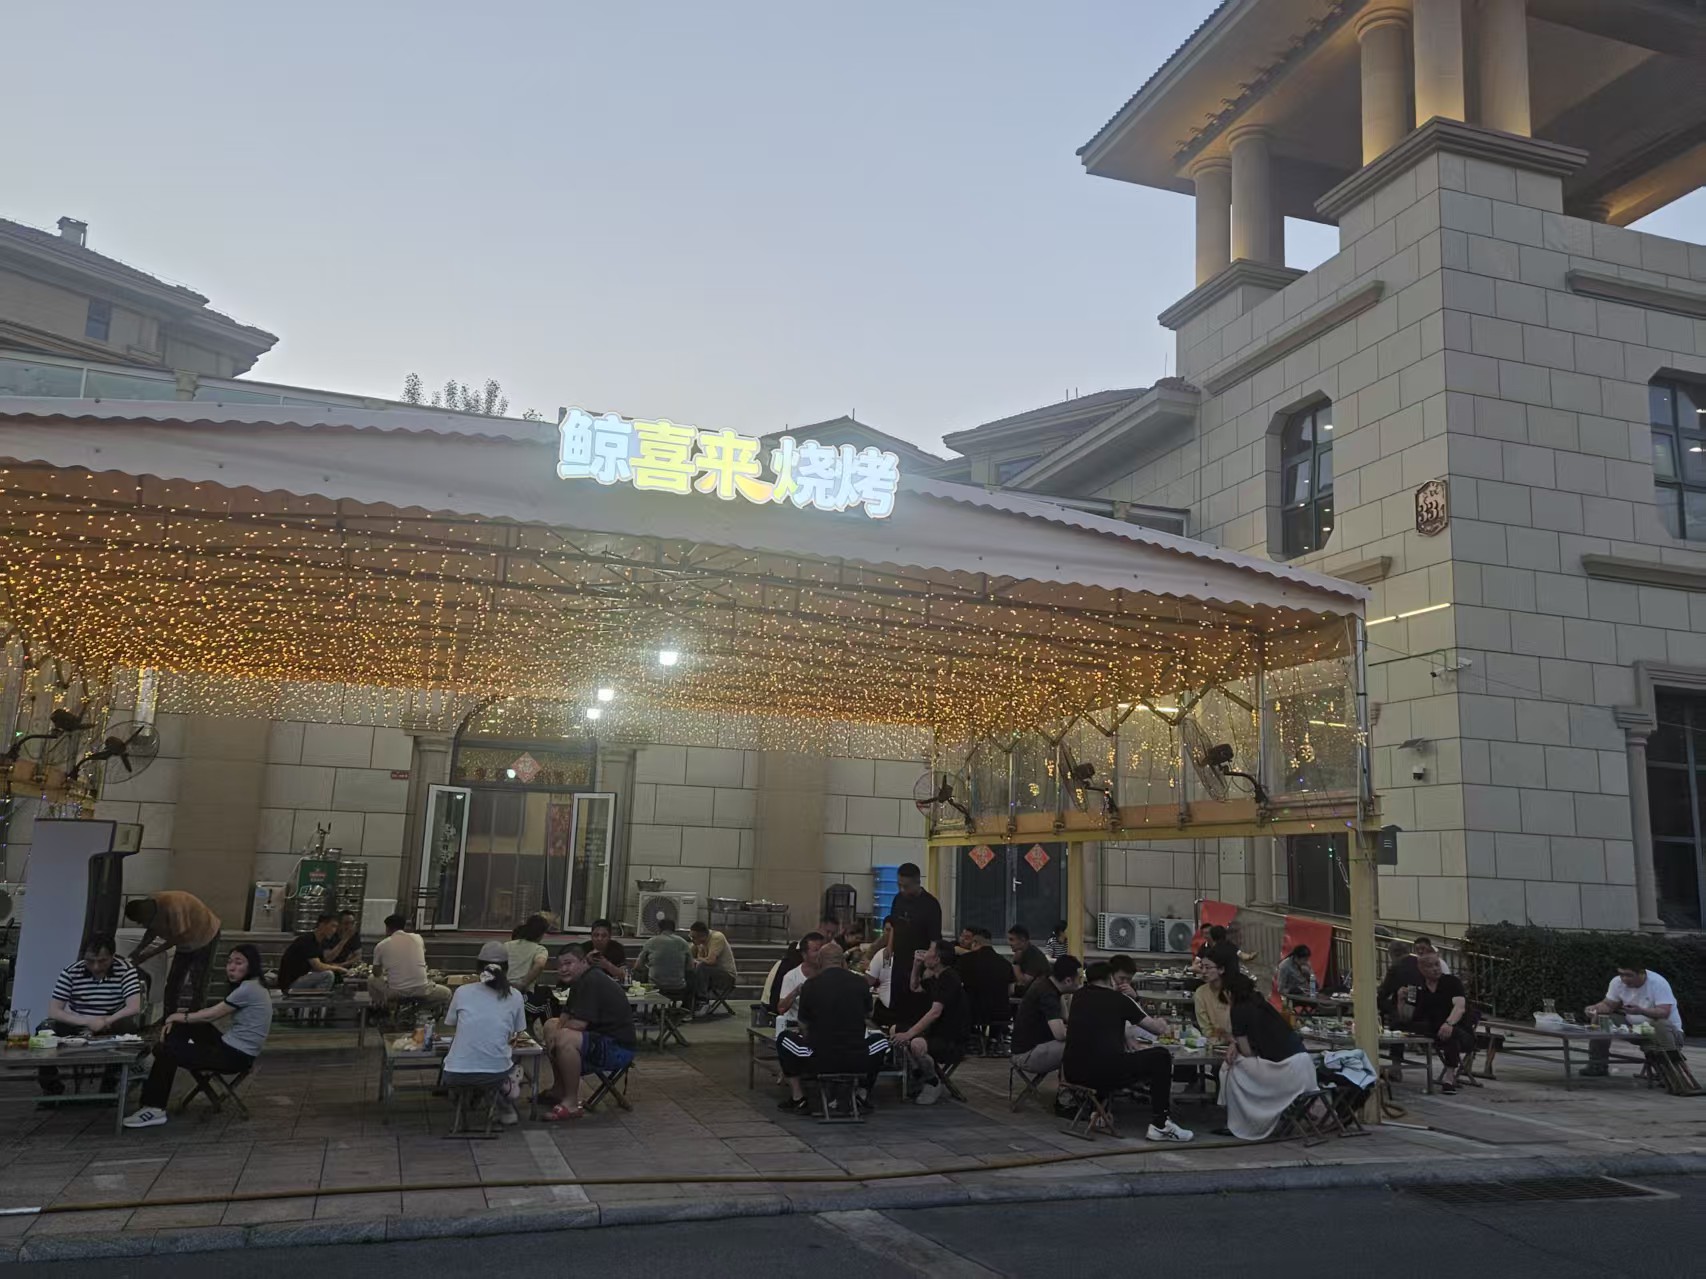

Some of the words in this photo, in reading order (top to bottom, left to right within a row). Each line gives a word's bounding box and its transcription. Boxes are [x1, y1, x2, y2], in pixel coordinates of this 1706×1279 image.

[558, 407, 899, 517] 鲸喜来烧烤
